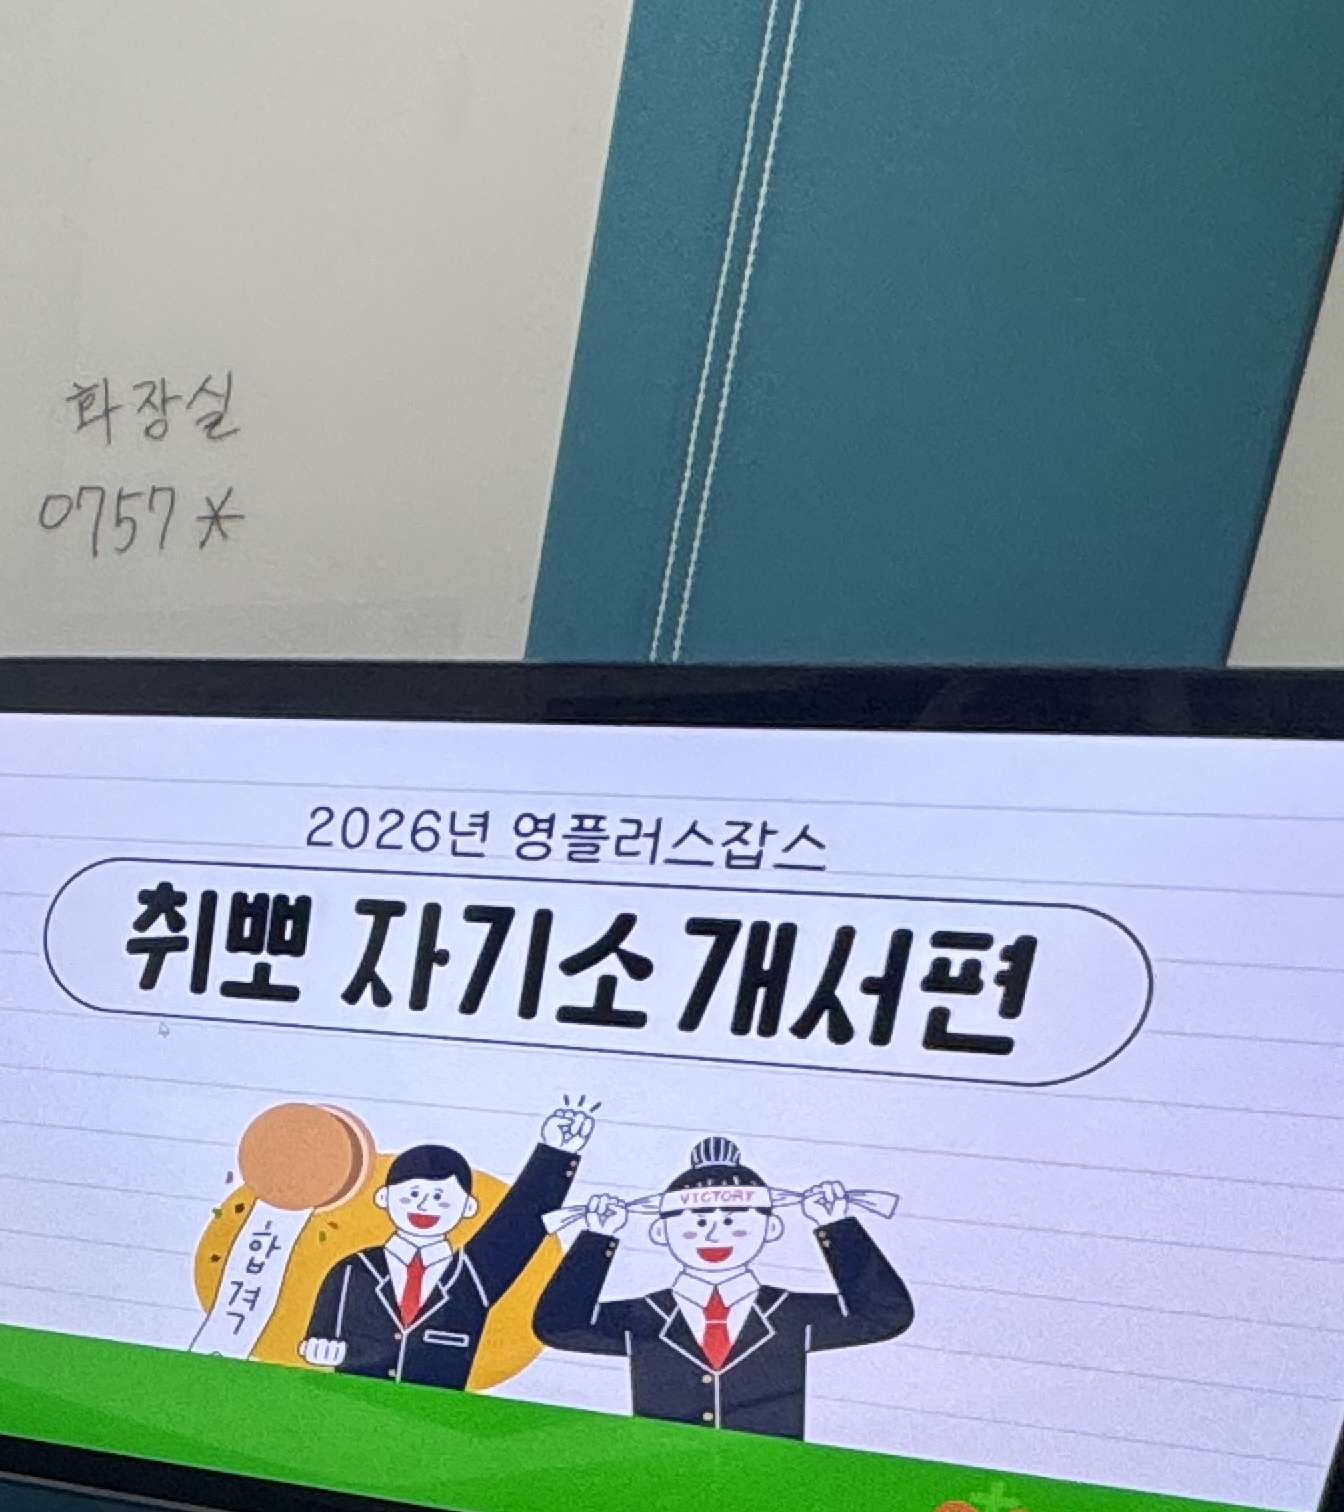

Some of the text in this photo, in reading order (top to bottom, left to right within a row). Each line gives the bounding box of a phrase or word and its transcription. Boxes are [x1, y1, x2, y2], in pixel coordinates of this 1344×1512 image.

[65, 370, 241, 446] 화장실
[305, 805, 827, 872] 2026년 영플러스잡스
[125, 881, 1039, 1056] 취뽀 자기소개서편
